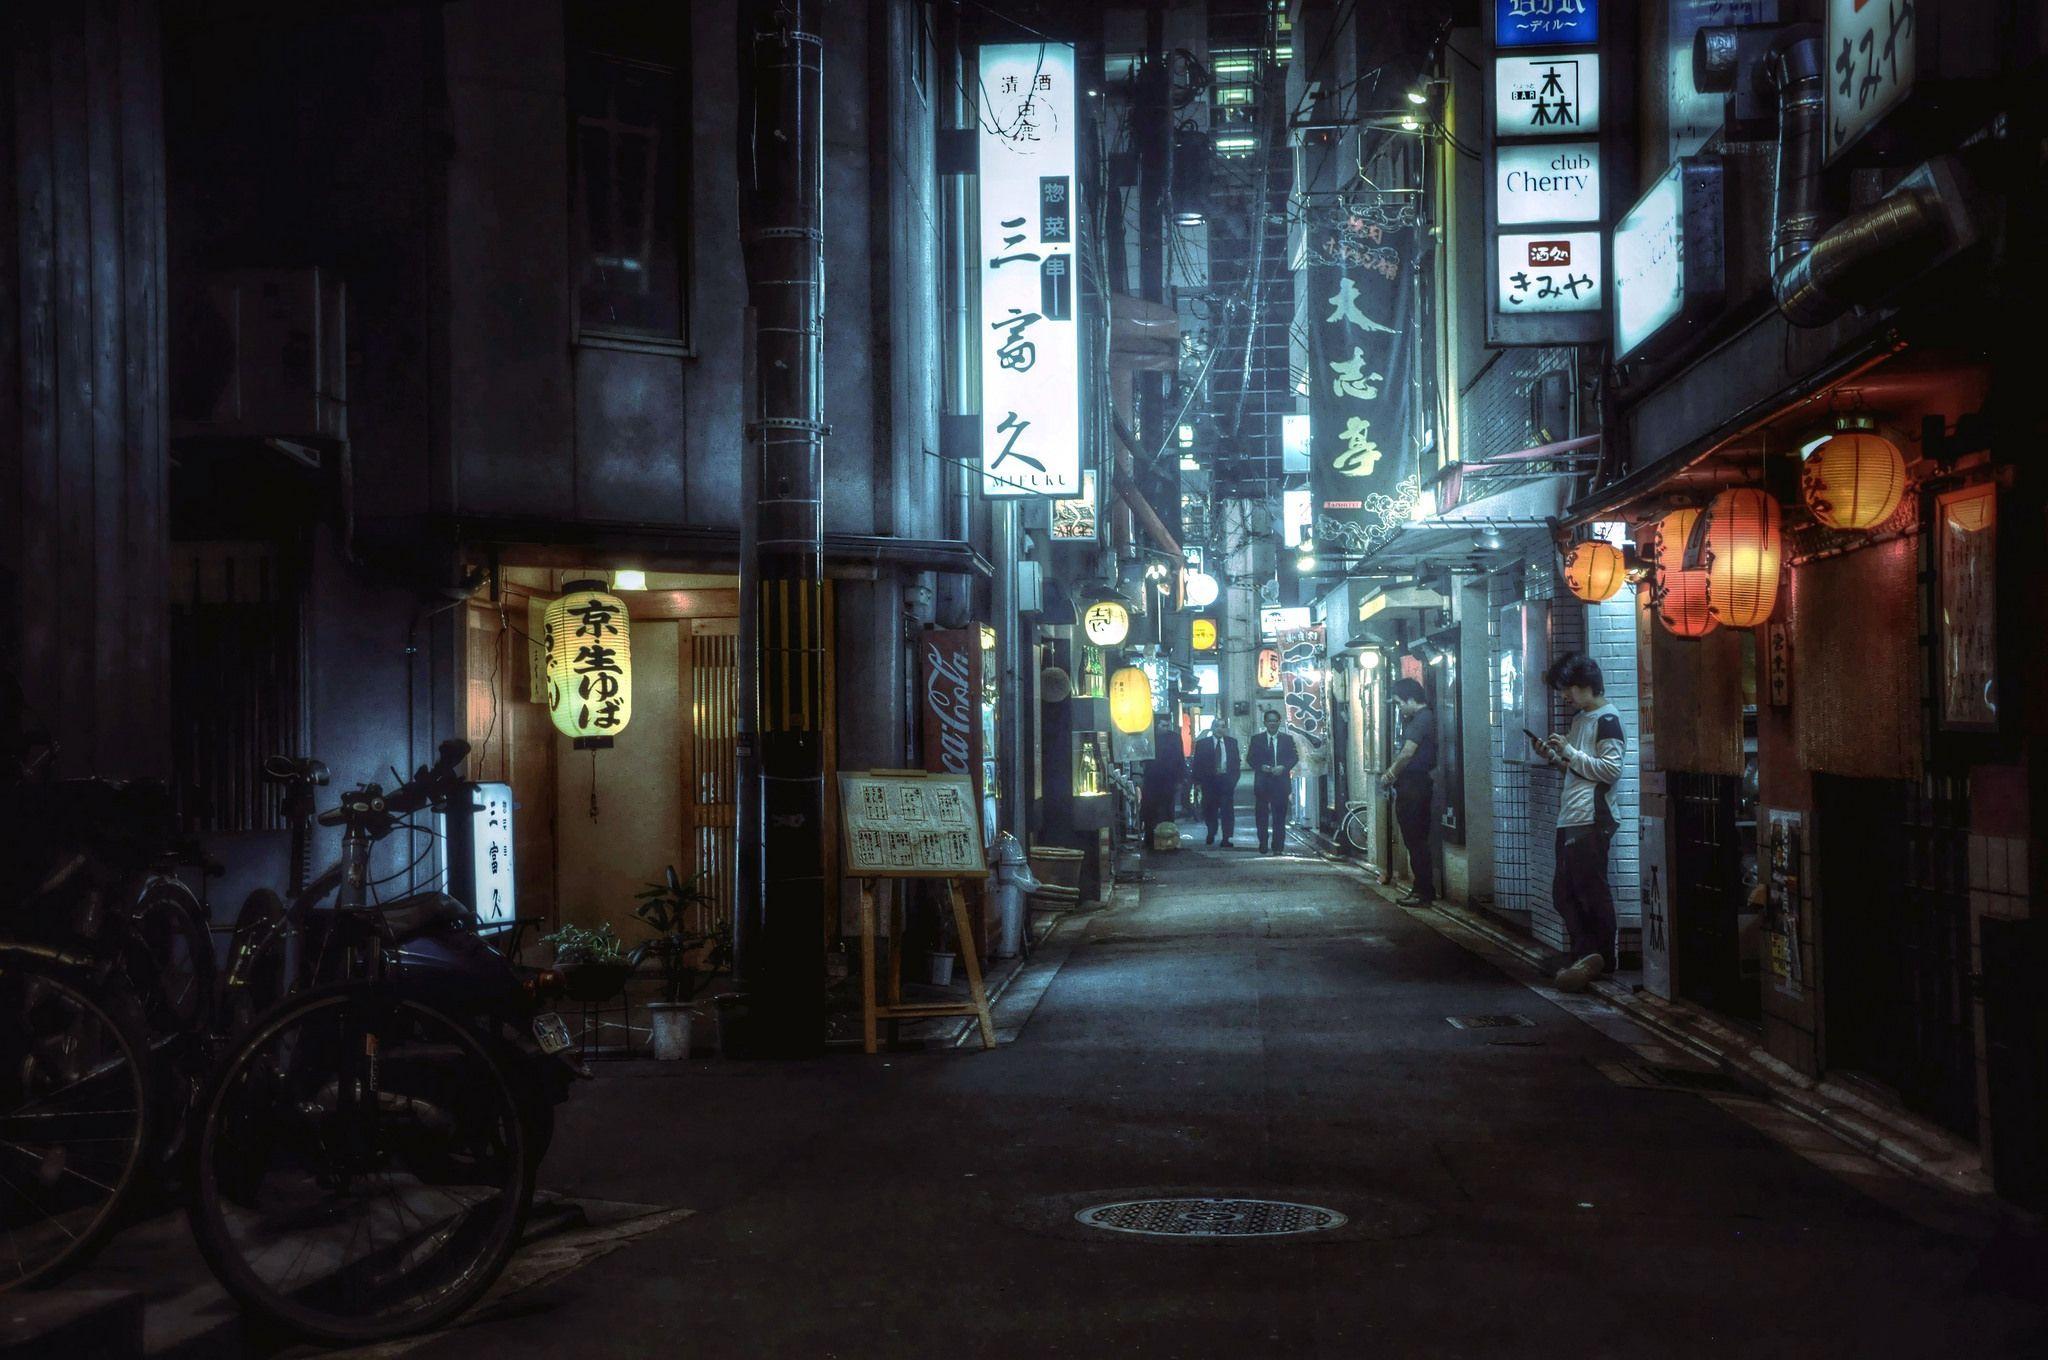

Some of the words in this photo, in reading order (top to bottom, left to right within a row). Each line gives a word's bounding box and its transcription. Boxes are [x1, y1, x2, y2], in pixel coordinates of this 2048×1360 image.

[1512, 91, 1536, 100] BAR
[1551, 154, 1591, 170] club
[1507, 171, 1588, 194] Cherry
[1530, 246, 1571, 263] 酒処
[1509, 271, 1594, 304] きみや
[927, 641, 970, 774] ca-Cola
